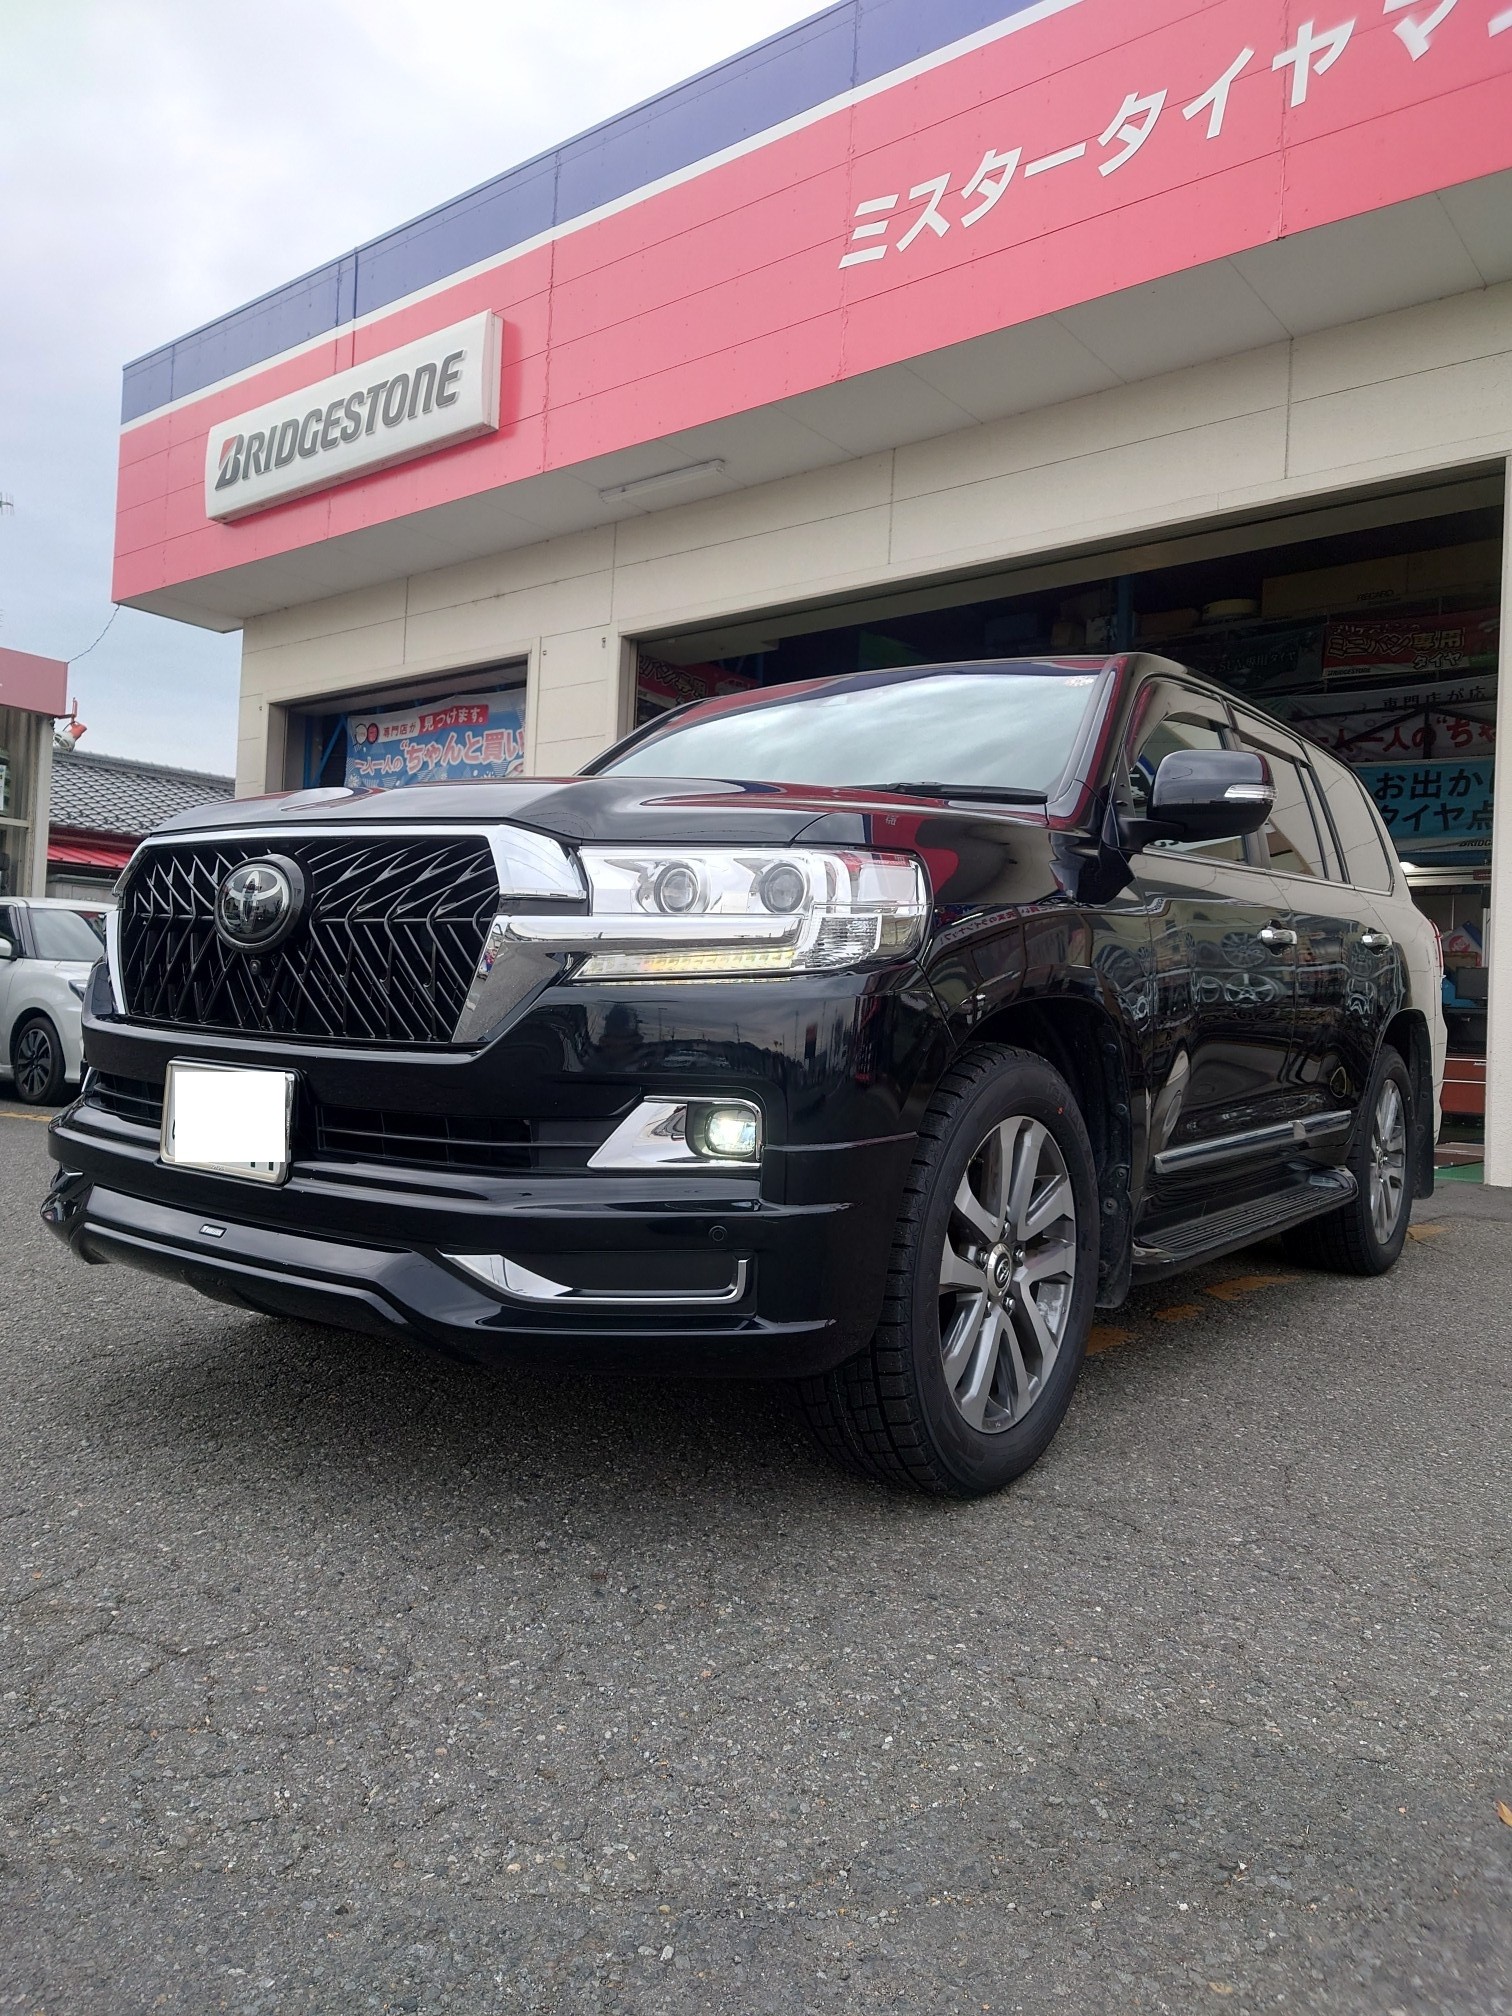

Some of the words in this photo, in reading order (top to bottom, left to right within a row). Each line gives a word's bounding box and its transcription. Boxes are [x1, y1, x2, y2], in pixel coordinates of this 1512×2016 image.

[839, 0, 1512, 269] ミスタータイヤマ
[214, 349, 466, 491] BRIDGESTONE
[1374, 768, 1495, 800] お出か
